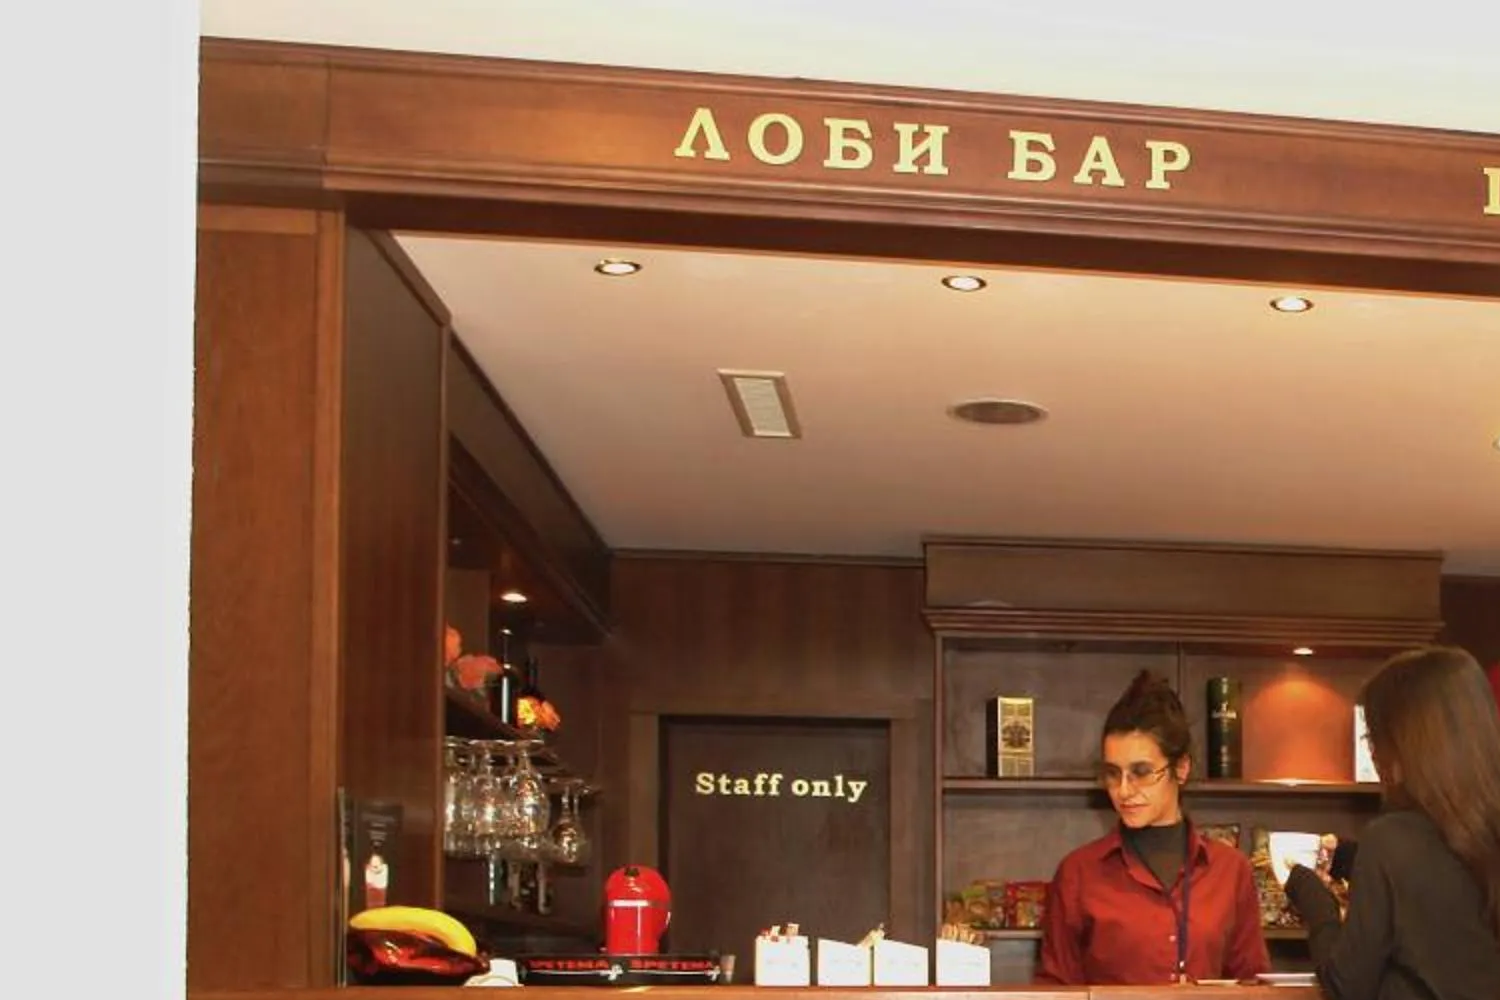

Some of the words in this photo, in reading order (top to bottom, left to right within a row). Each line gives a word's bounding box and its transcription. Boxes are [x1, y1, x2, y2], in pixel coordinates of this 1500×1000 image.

[673, 107, 949, 176] ЛОБИ
[1006, 128, 1191, 190] БАР
[695, 772, 784, 796] Staff
[790, 774, 868, 803] only
